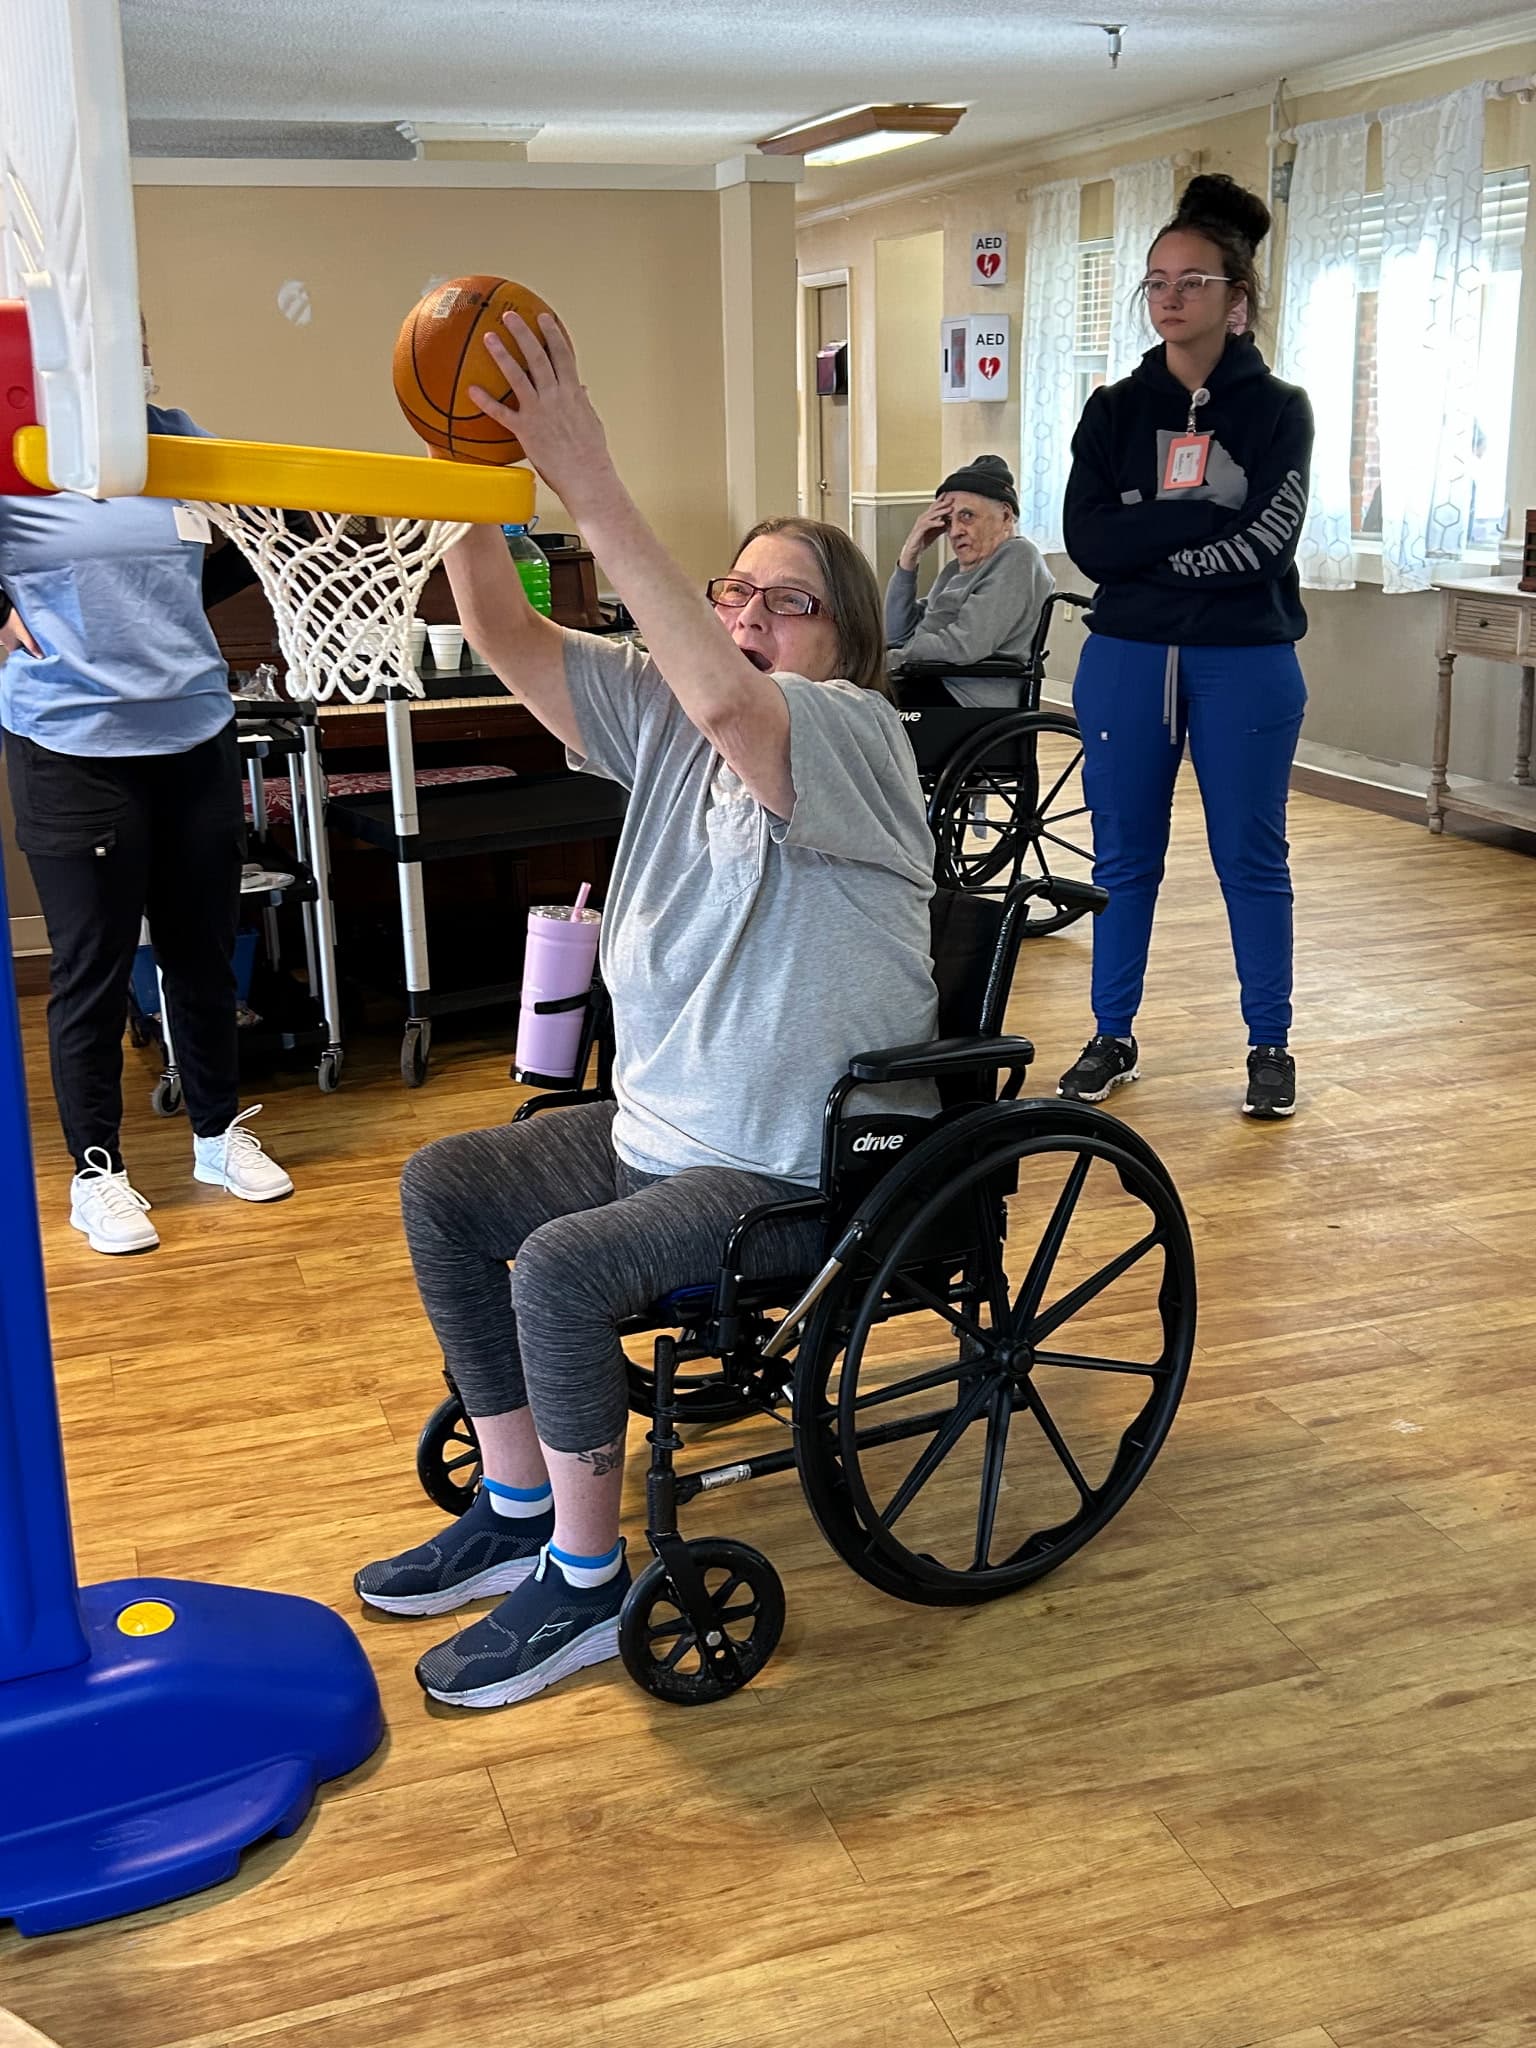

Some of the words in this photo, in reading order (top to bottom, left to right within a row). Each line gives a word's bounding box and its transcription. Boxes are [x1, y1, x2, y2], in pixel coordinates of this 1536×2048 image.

[976, 237, 1002, 250] AED
[975, 333, 1005, 346] AED
[1246, 469, 1308, 556] JASON
[852, 1132, 905, 1153] drive
